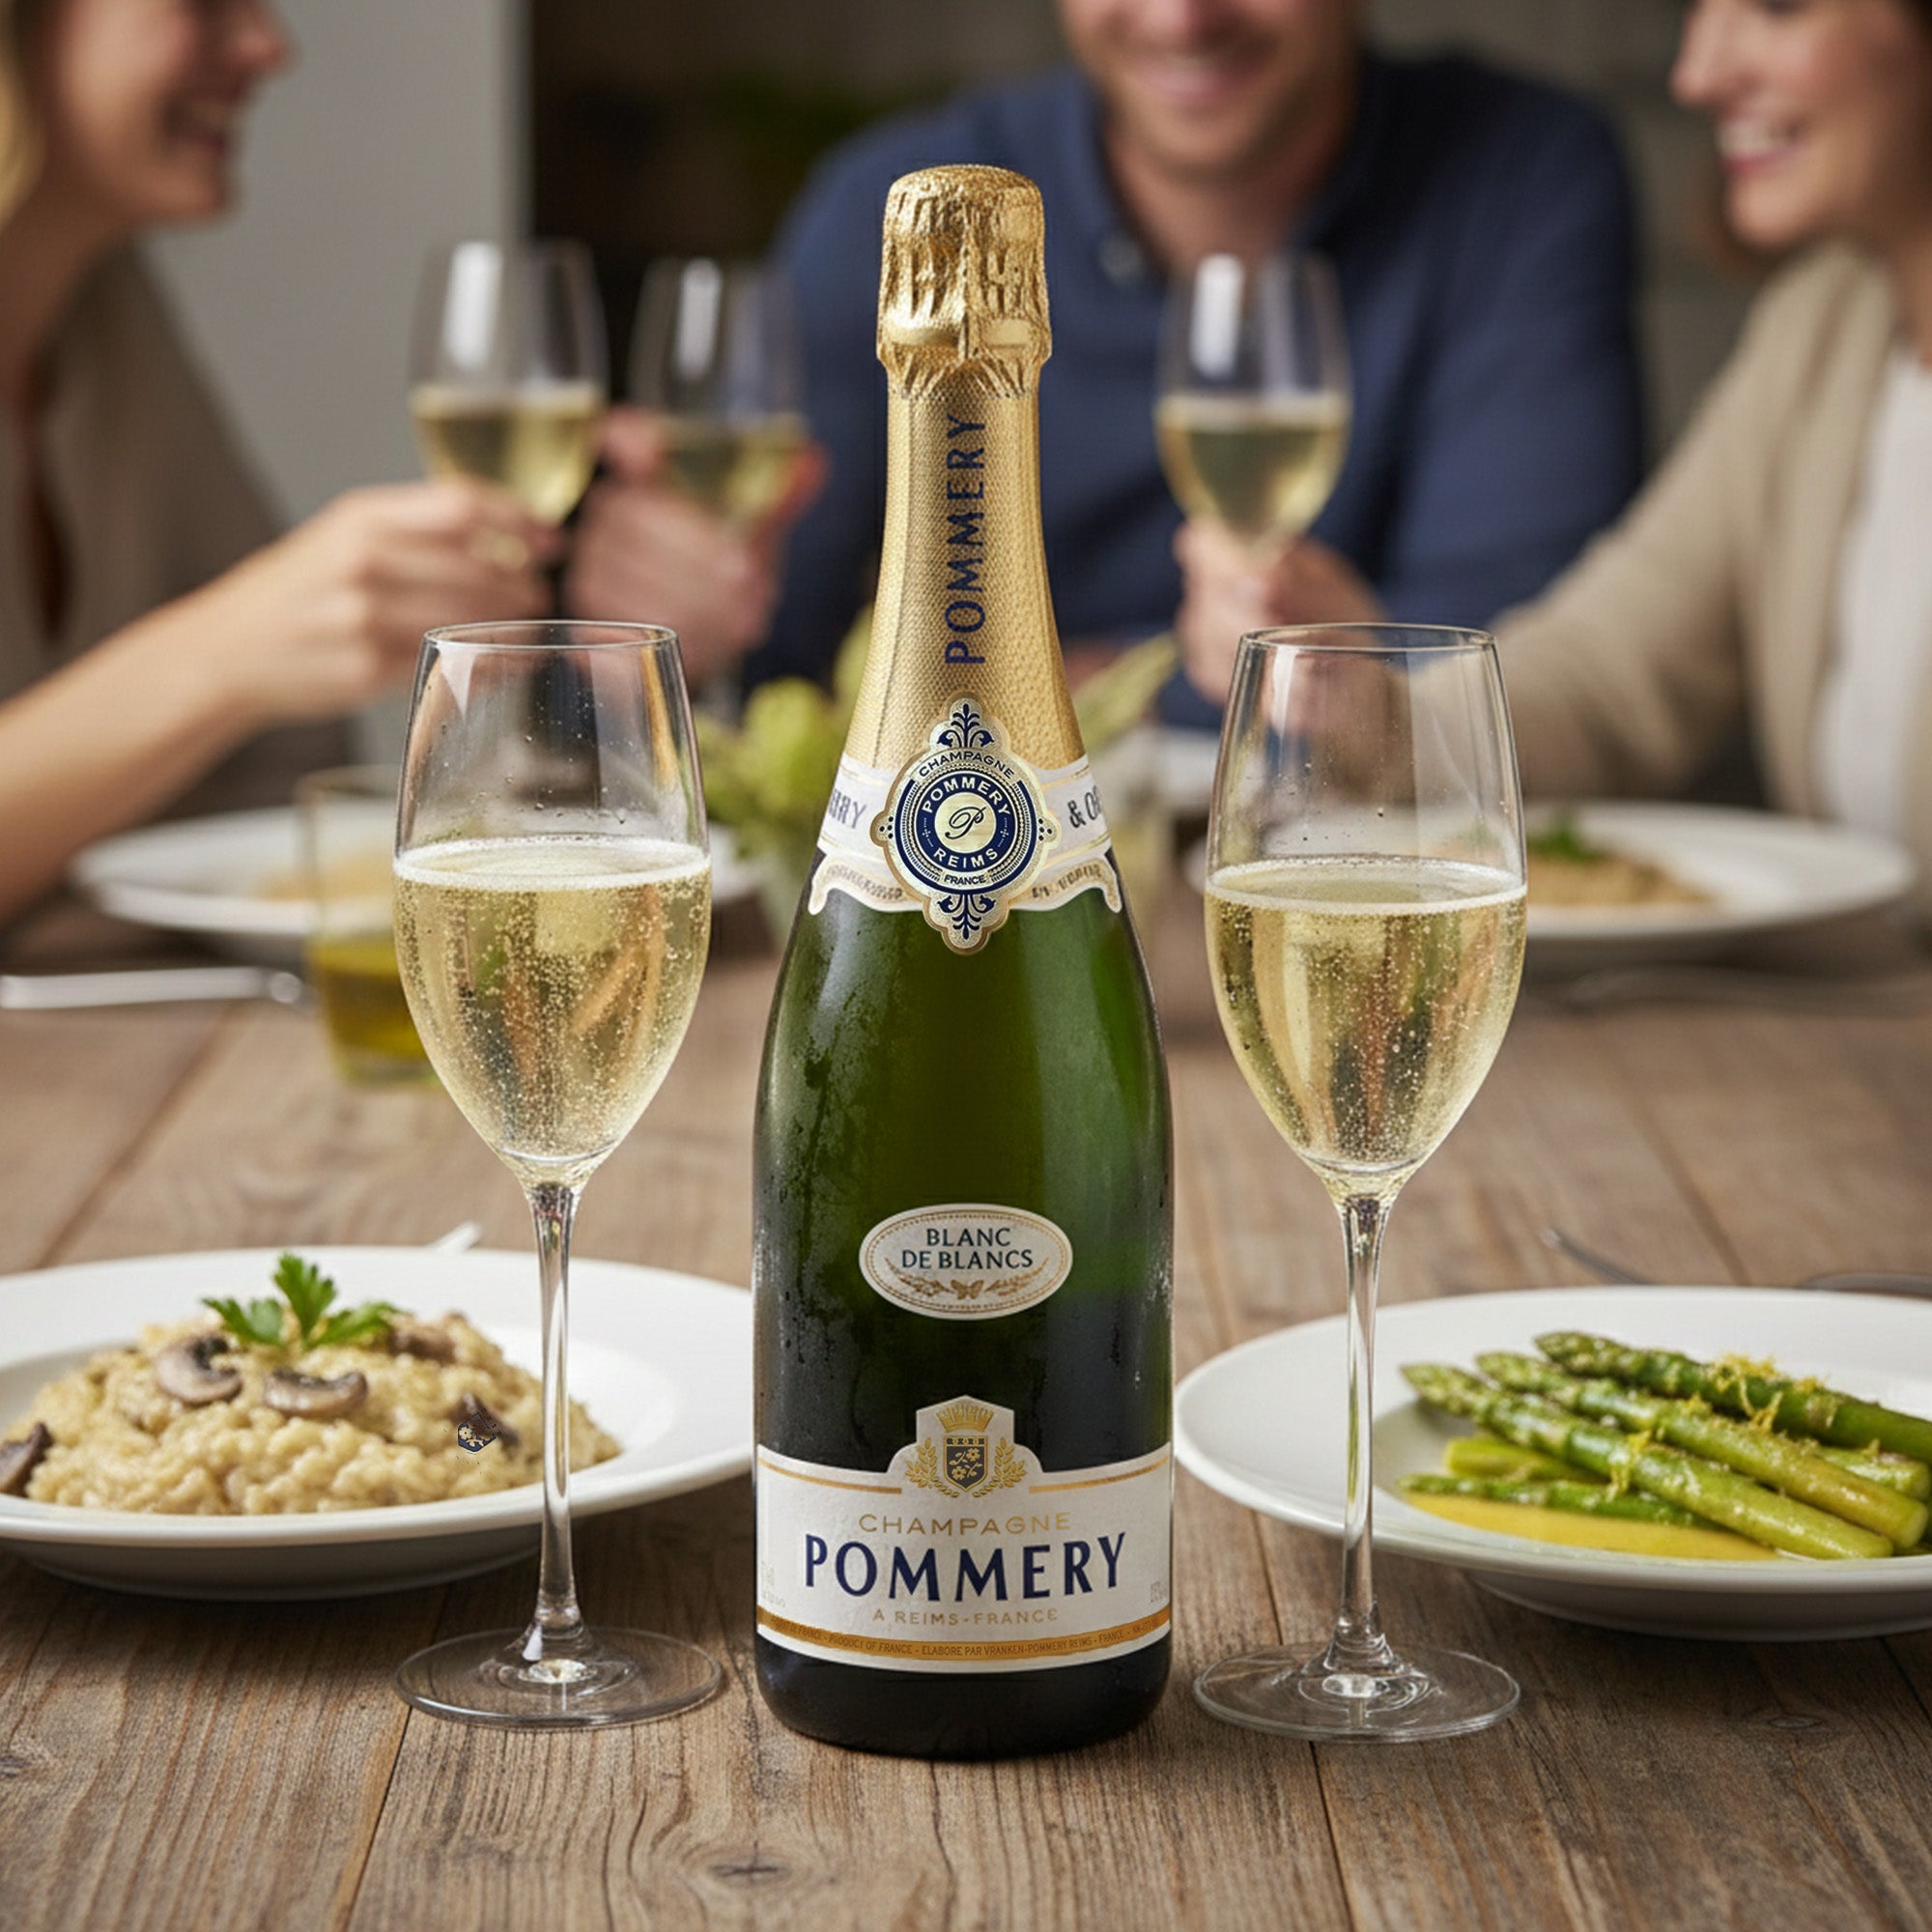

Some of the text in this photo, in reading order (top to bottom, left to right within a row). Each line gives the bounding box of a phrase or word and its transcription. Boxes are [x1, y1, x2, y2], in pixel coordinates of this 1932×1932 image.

[945, 413, 985, 665] POMMERY
[919, 751, 1015, 780] CHAMPAGNE
[922, 776, 1011, 815] POMMERY
[1067, 799, 1087, 828] &
[933, 848, 998, 869] REIMS
[943, 874, 986, 886] FRANCE
[926, 1227, 1011, 1247] BLANC
[901, 1249, 1034, 1269] DE BLANCS
[858, 1511, 1072, 1537] CHAMPAGNE
[805, 1531, 1126, 1602] POMMERY
[829, 1634, 864, 1650] PRODUCT
[865, 1641, 877, 1651] OF
[878, 1642, 914, 1655] FRANCE
[964, 1646, 982, 1656] PAR
